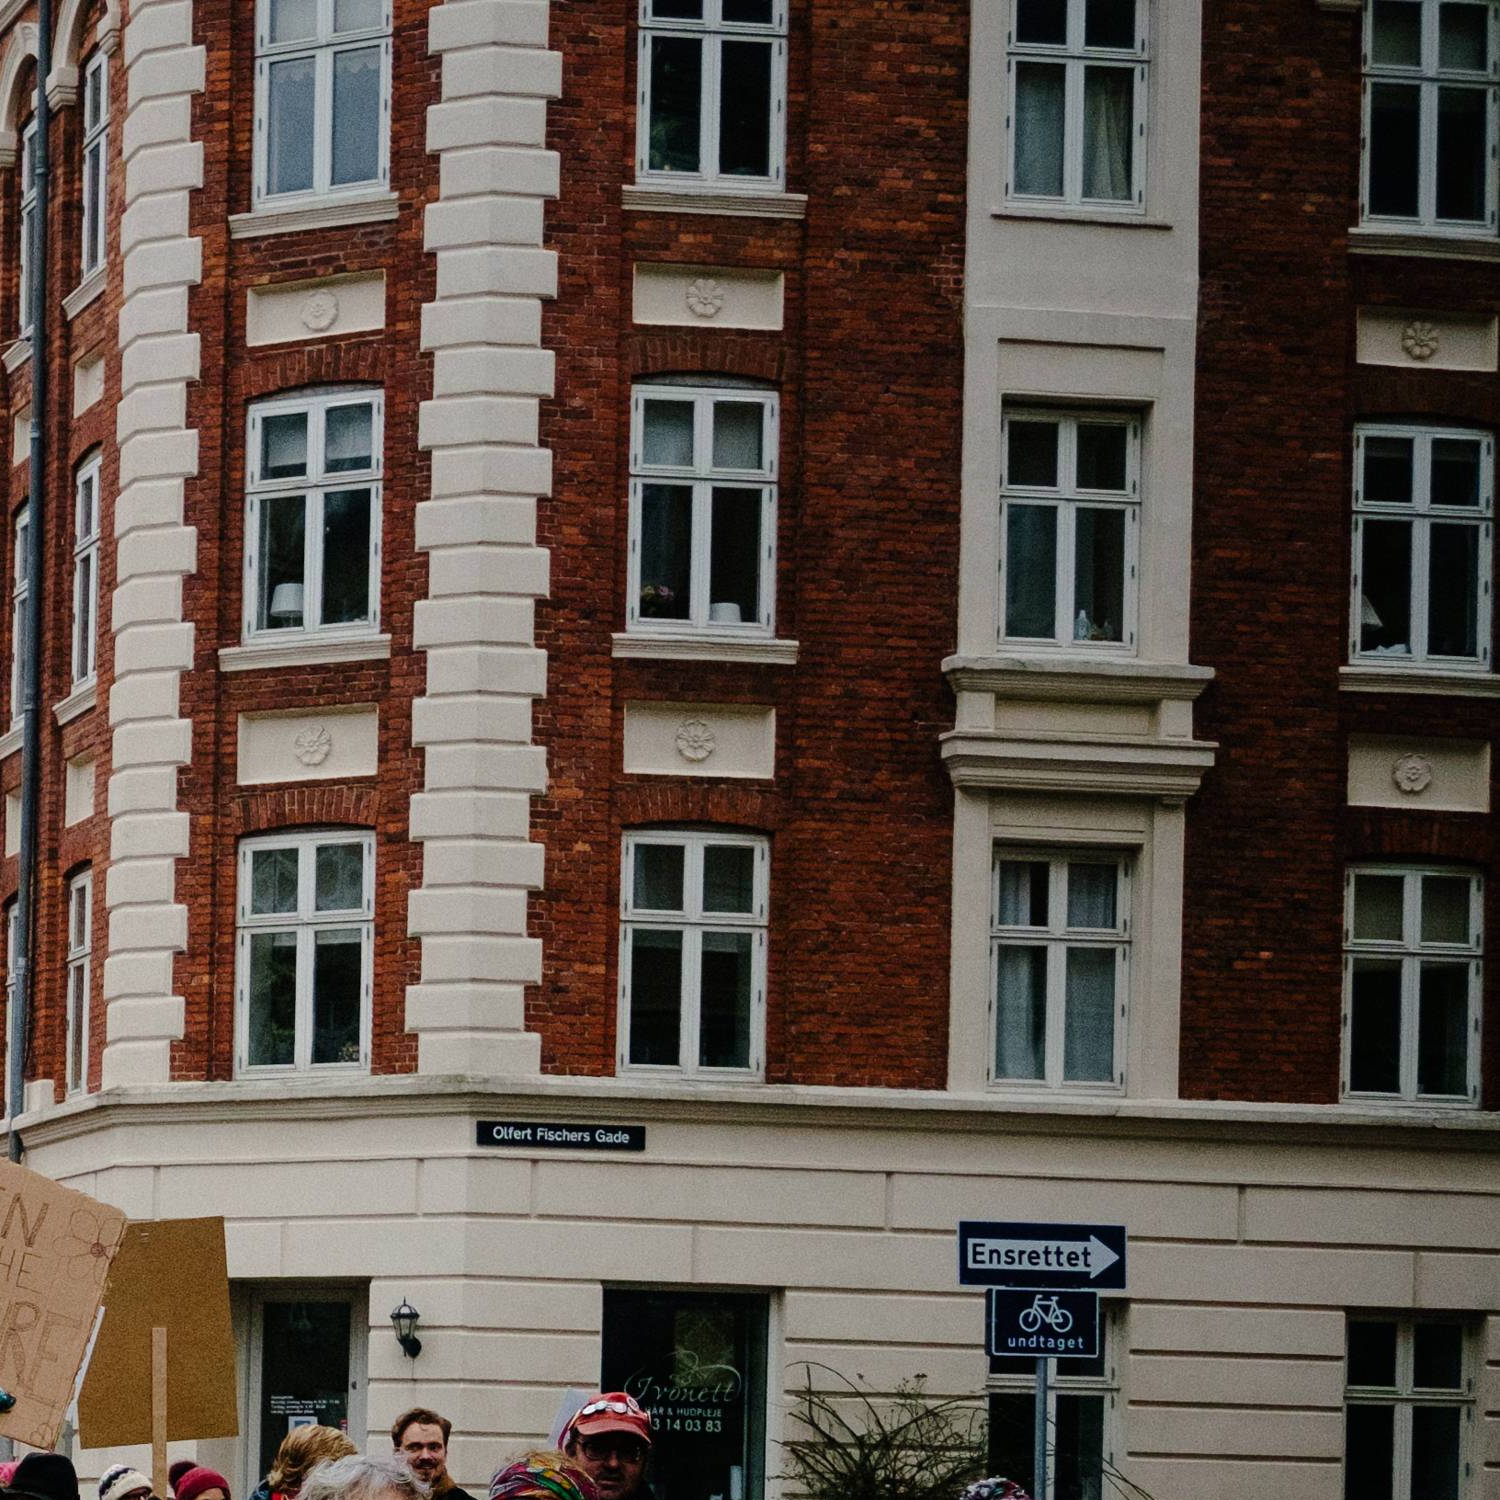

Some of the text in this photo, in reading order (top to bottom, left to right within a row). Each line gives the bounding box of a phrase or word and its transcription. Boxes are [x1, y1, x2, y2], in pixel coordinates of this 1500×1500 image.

[492, 1125, 630, 1144] Olfert Fischers Gade
[972, 1243, 1091, 1268] Ensrettet
[1007, 1335, 1084, 1350] undtaget
[676, 1407, 723, 1417] HUDPLEJE
[666, 1418, 681, 1431] 14
[685, 1419, 702, 1432] 03
[705, 1420, 722, 1433] 83
